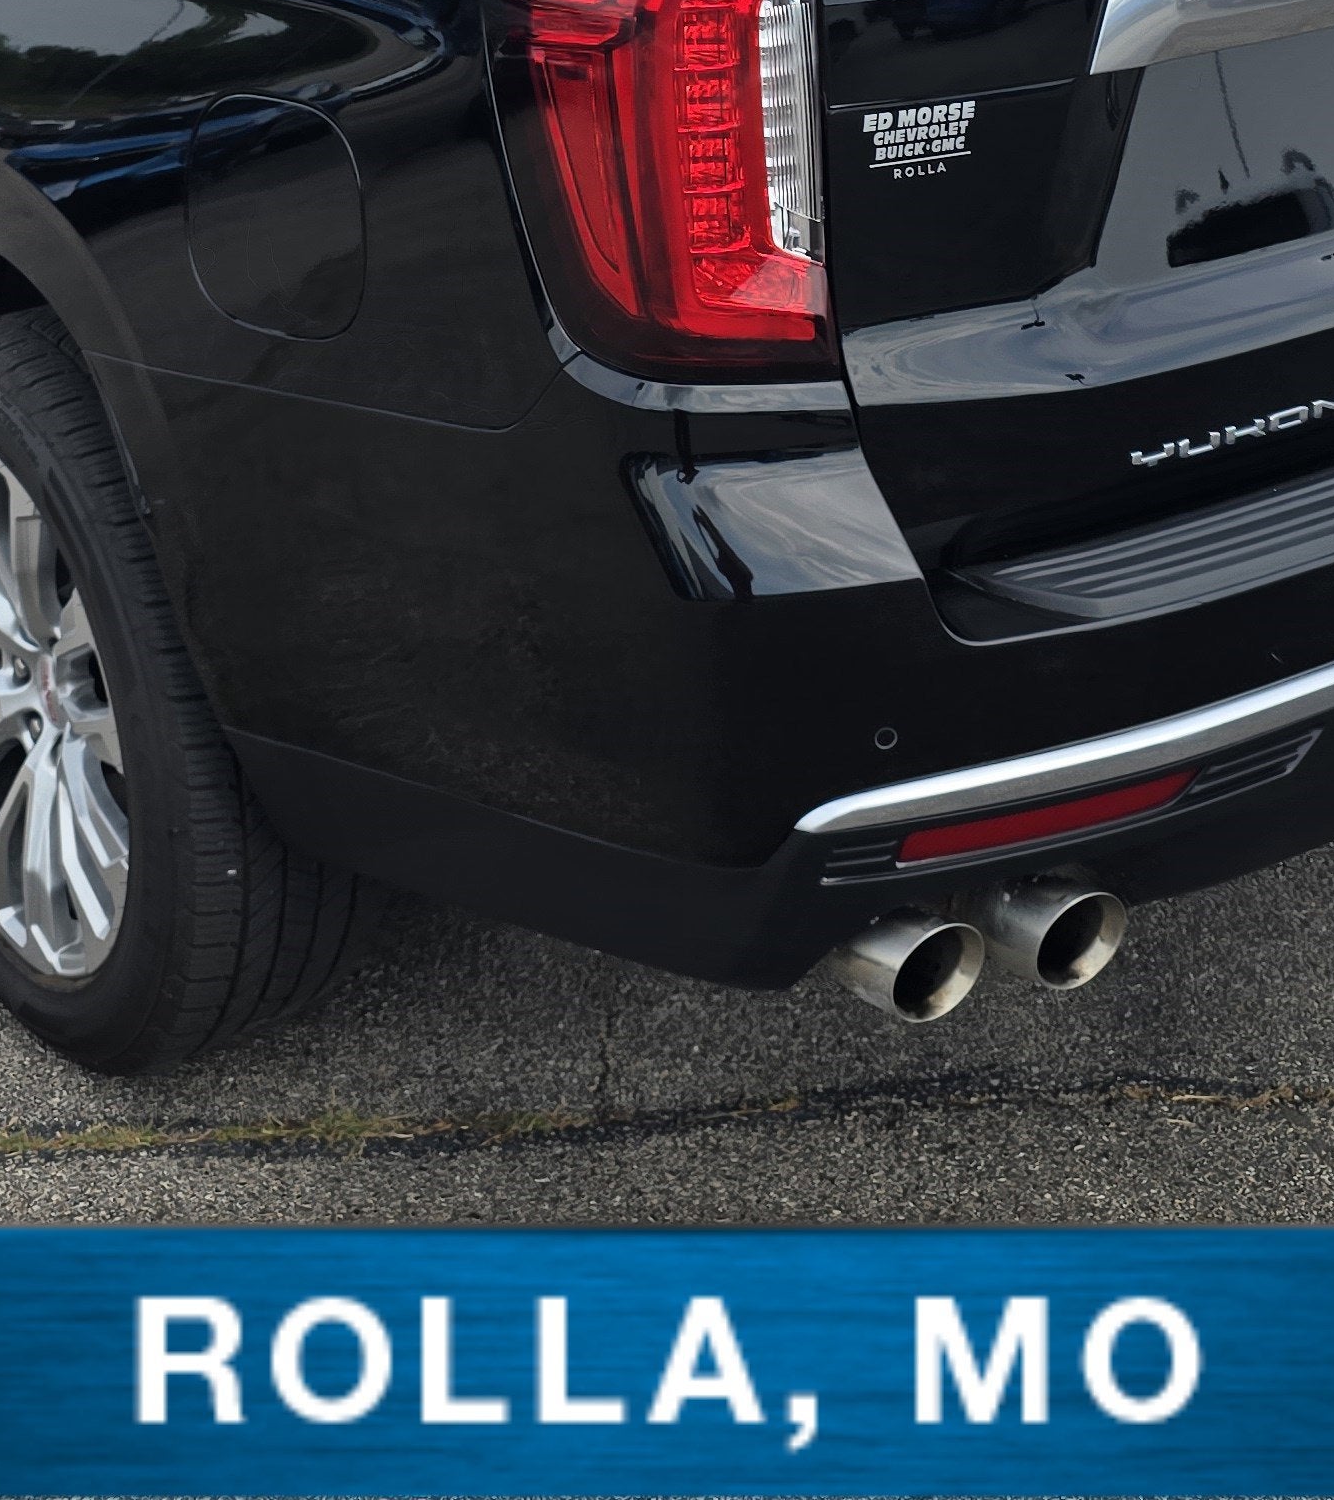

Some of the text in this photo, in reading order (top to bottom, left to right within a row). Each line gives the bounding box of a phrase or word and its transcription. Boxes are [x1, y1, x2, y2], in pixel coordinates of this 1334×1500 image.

[863, 101, 975, 132] ED MORSE
[873, 120, 968, 146] CHEVROLET
[893, 162, 946, 179] ROLLA
